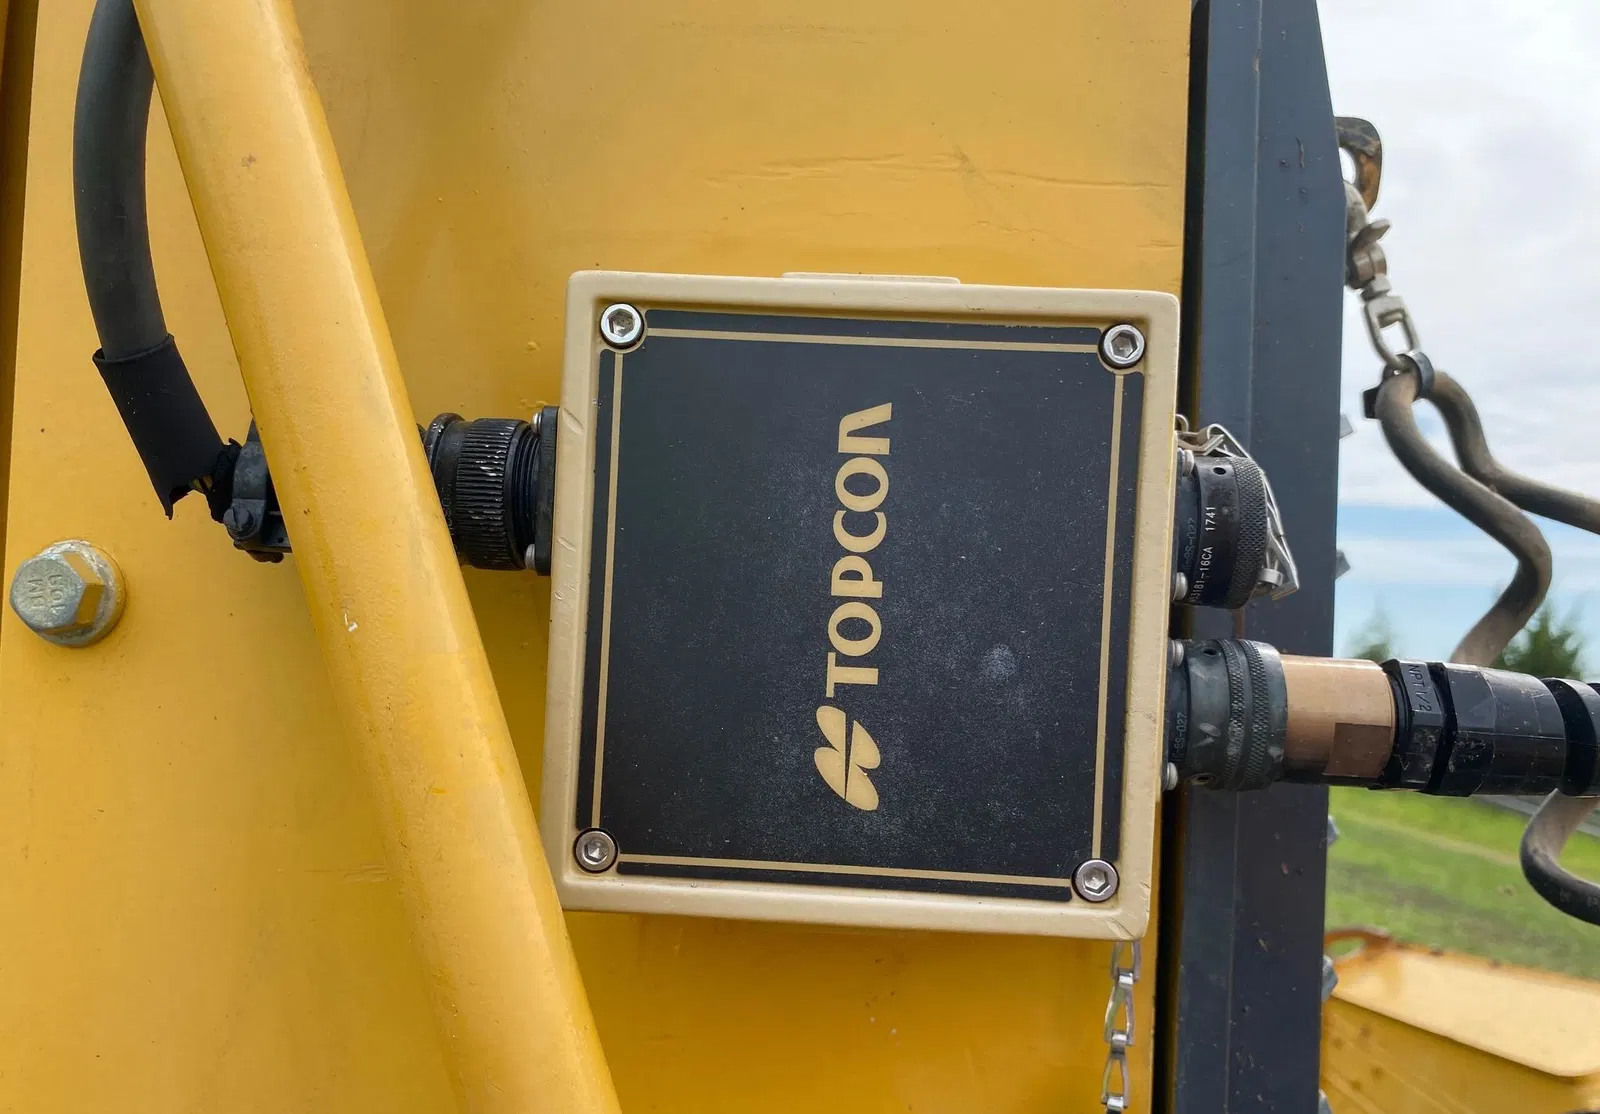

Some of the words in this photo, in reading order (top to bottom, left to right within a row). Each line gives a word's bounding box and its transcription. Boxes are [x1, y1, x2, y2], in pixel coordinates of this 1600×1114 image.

[1205, 506, 1217, 532] 1741
[825, 402, 892, 698] TOPCON
[1407, 664, 1426, 687] NPT
